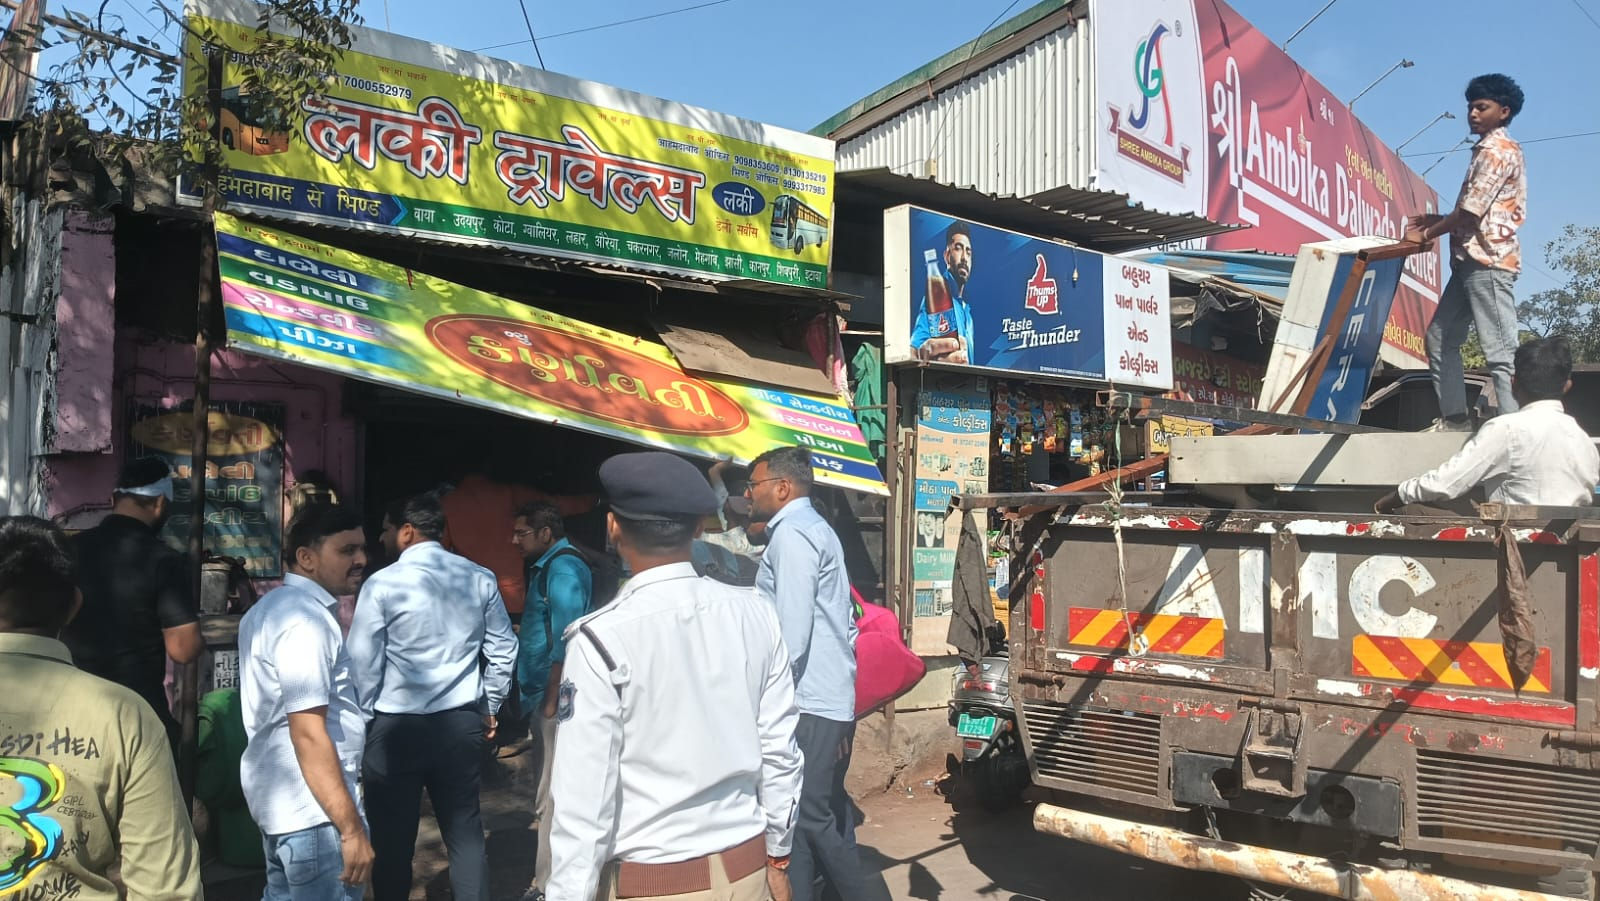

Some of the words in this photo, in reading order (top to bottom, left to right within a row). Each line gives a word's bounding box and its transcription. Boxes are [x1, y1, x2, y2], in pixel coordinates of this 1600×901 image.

[344, 75, 413, 100] 7000552979
[302, 95, 483, 187] लकी
[1119, 136, 1141, 158] SHREE
[1140, 145, 1163, 168] AMBIKA
[1162, 155, 1182, 177] GROUP
[1245, 99, 1330, 218] Ambika
[493, 123, 707, 226] ट्रावेल्स
[306, 183, 325, 209] से
[336, 188, 382, 218] भिण्ड
[723, 187, 755, 214] लकी
[414, 207, 436, 224] वाया
[253, 248, 359, 287] દાબેલી
[1121, 264, 1151, 288] બહુચર
[249, 269, 369, 311] વડાપાઉ
[1028, 285, 1056, 299] Thums
[1115, 293, 1133, 310] પાન
[1136, 293, 1159, 316] પાર્લર
[1002, 317, 1033, 333] Taste
[1007, 331, 1022, 342] The
[1019, 325, 1081, 349] Thunder
[1127, 321, 1150, 343] એન્ડ
[916, 552, 937, 567] Dairy
[1155, 543, 1438, 639] AMC
